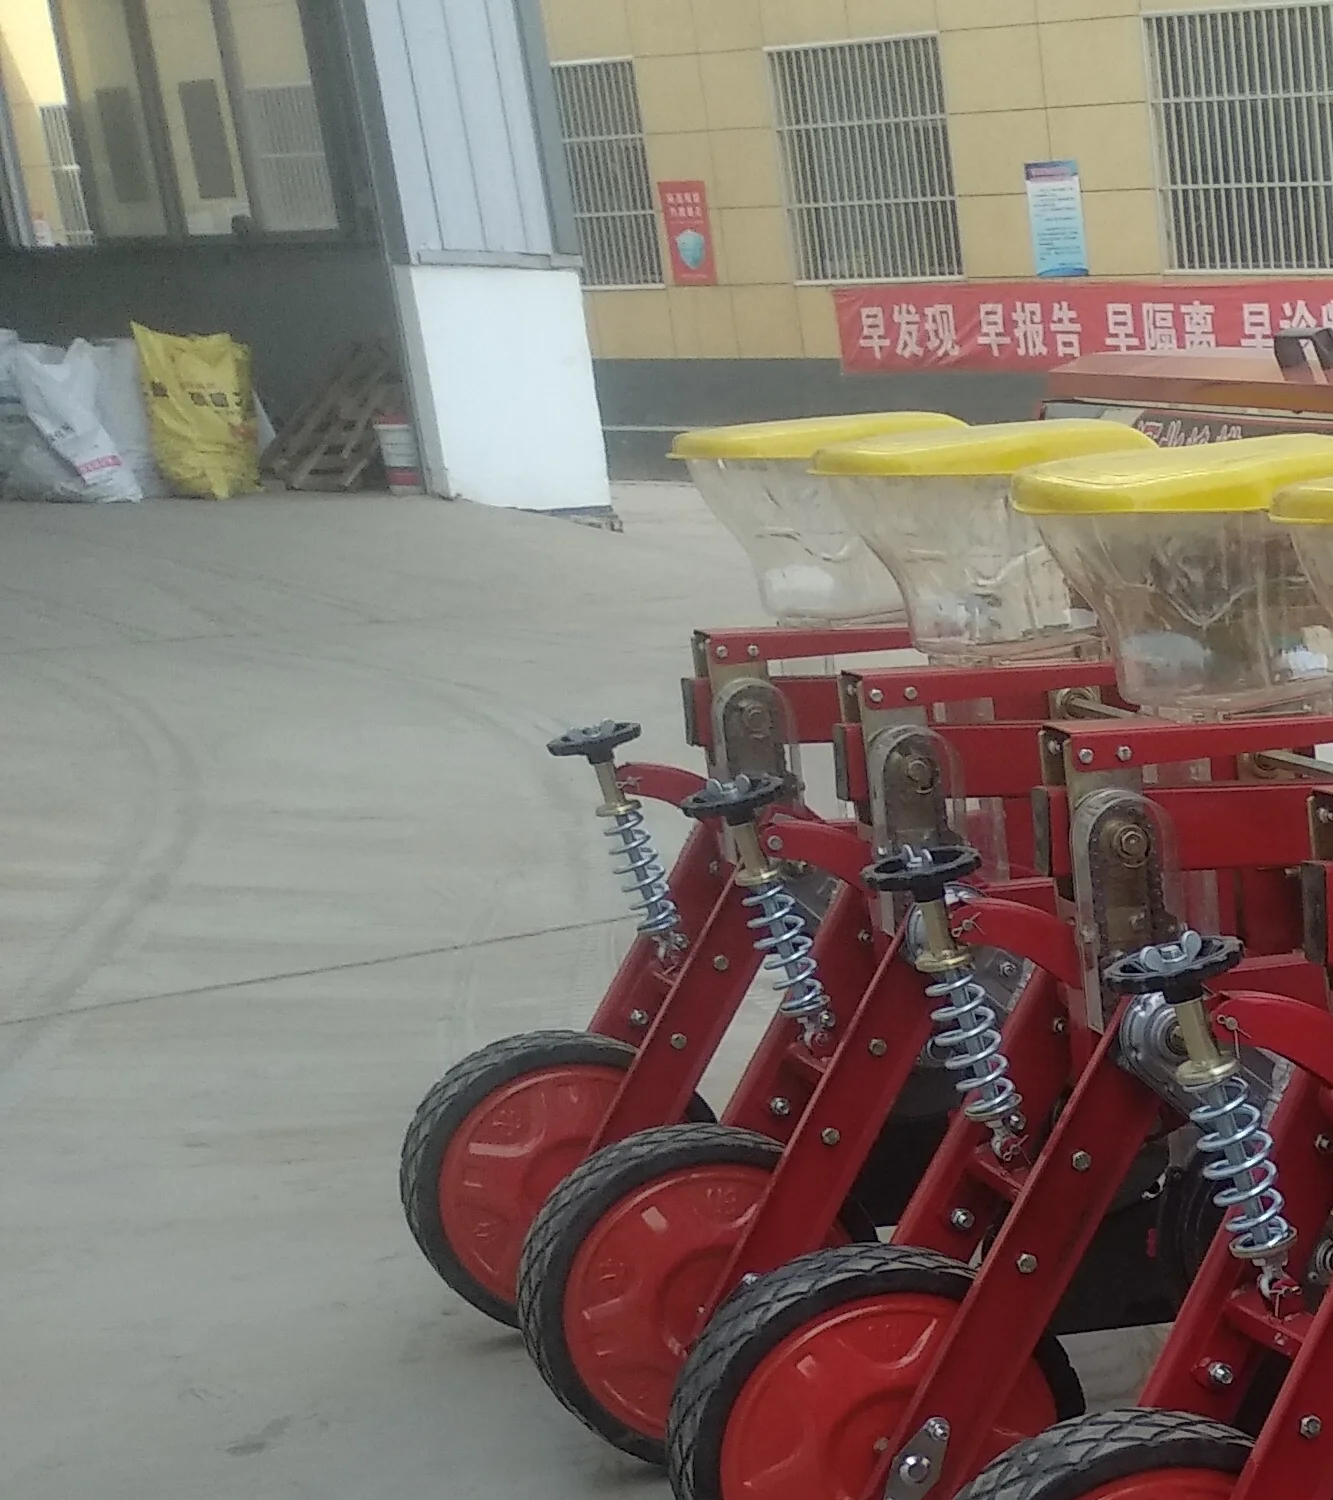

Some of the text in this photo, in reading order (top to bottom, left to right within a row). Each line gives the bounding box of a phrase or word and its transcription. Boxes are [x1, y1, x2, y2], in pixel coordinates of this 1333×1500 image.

[859, 301, 960, 360] 早发现
[977, 300, 1082, 358] 早报告
[1103, 299, 1217, 352] 早隔离
